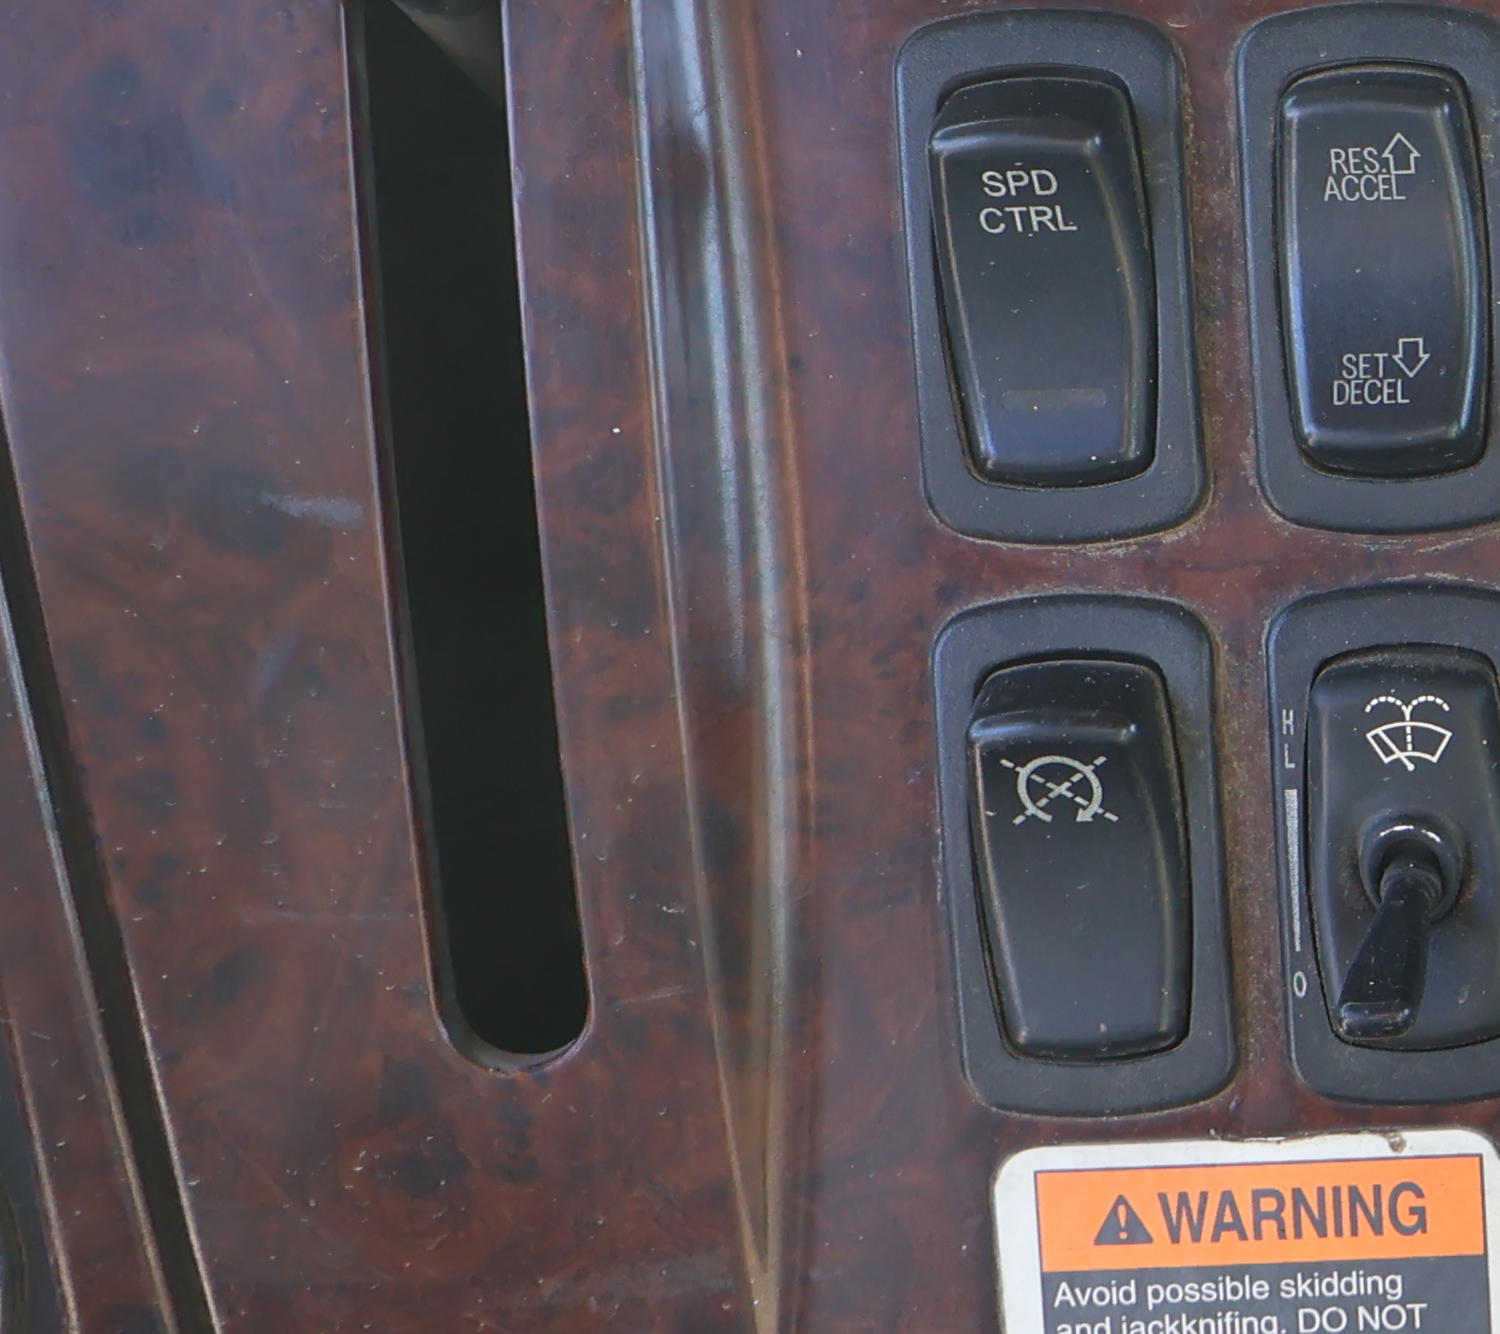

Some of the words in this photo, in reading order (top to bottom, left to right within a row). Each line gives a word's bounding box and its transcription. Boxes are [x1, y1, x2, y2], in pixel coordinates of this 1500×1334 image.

[1329, 147, 1384, 174] RES.
[982, 169, 1059, 197] SPD
[1323, 174, 1406, 202] ACCEL
[979, 205, 1077, 235] CTRL
[1341, 352, 1387, 379] SET
[1333, 379, 1410, 406] DECEL
[1282, 709, 1295, 737] H
[1283, 743, 1295, 769] L
[1158, 1181, 1428, 1245] WARNING
[1053, 1281, 1137, 1309] Avoid
[1146, 1276, 1270, 1310] possible
[1280, 1271, 1404, 1300] skidding
[1298, 1306, 1346, 1334] DO
[1357, 1303, 1428, 1332] NOT
